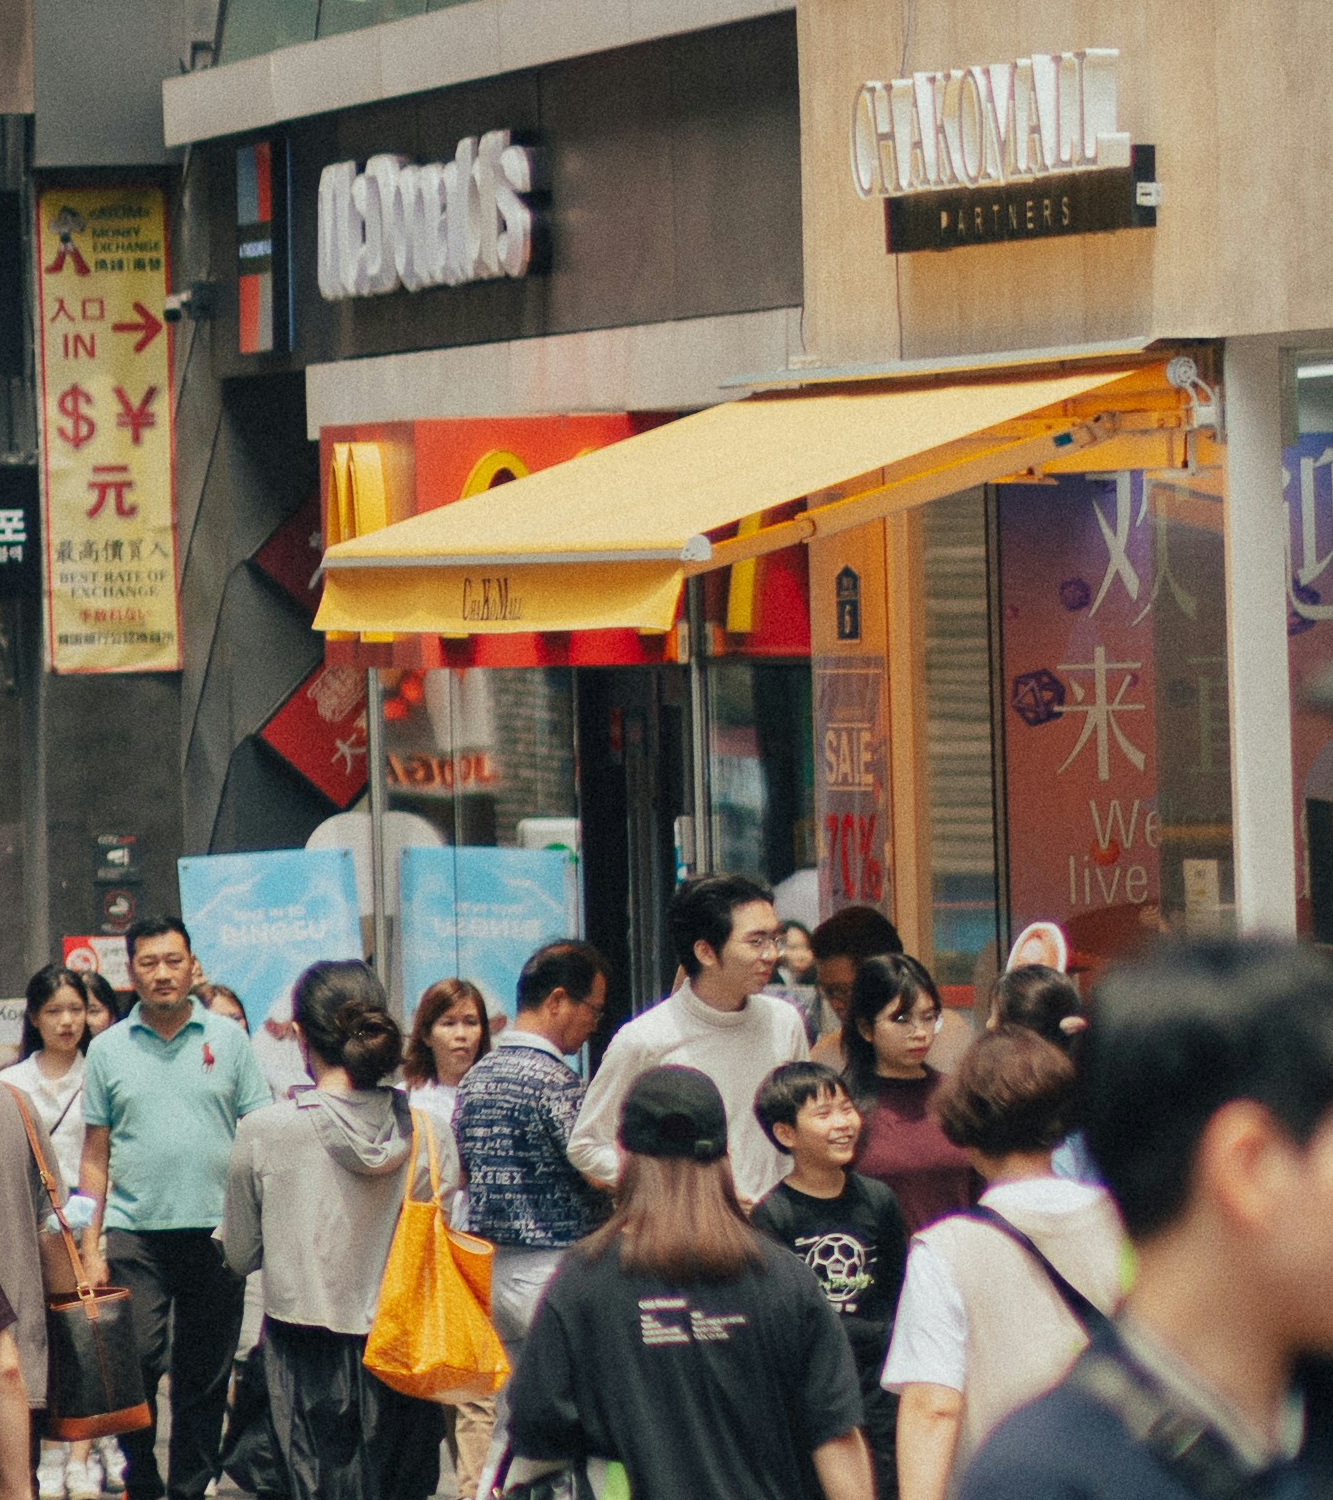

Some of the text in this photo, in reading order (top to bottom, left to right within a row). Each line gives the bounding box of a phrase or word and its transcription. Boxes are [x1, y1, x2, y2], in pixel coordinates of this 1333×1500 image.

[940, 197, 1071, 236] PARTNERS
[49, 297, 106, 324] 入口
[63, 332, 97, 360] IN
[56, 383, 158, 449] $ ¥
[86, 465, 138, 520] 元
[59, 569, 169, 584] BEST RATE OF
[70, 585, 158, 599] EXCHANGE
[824, 728, 875, 786] SALE
[1066, 856, 1149, 906] live
